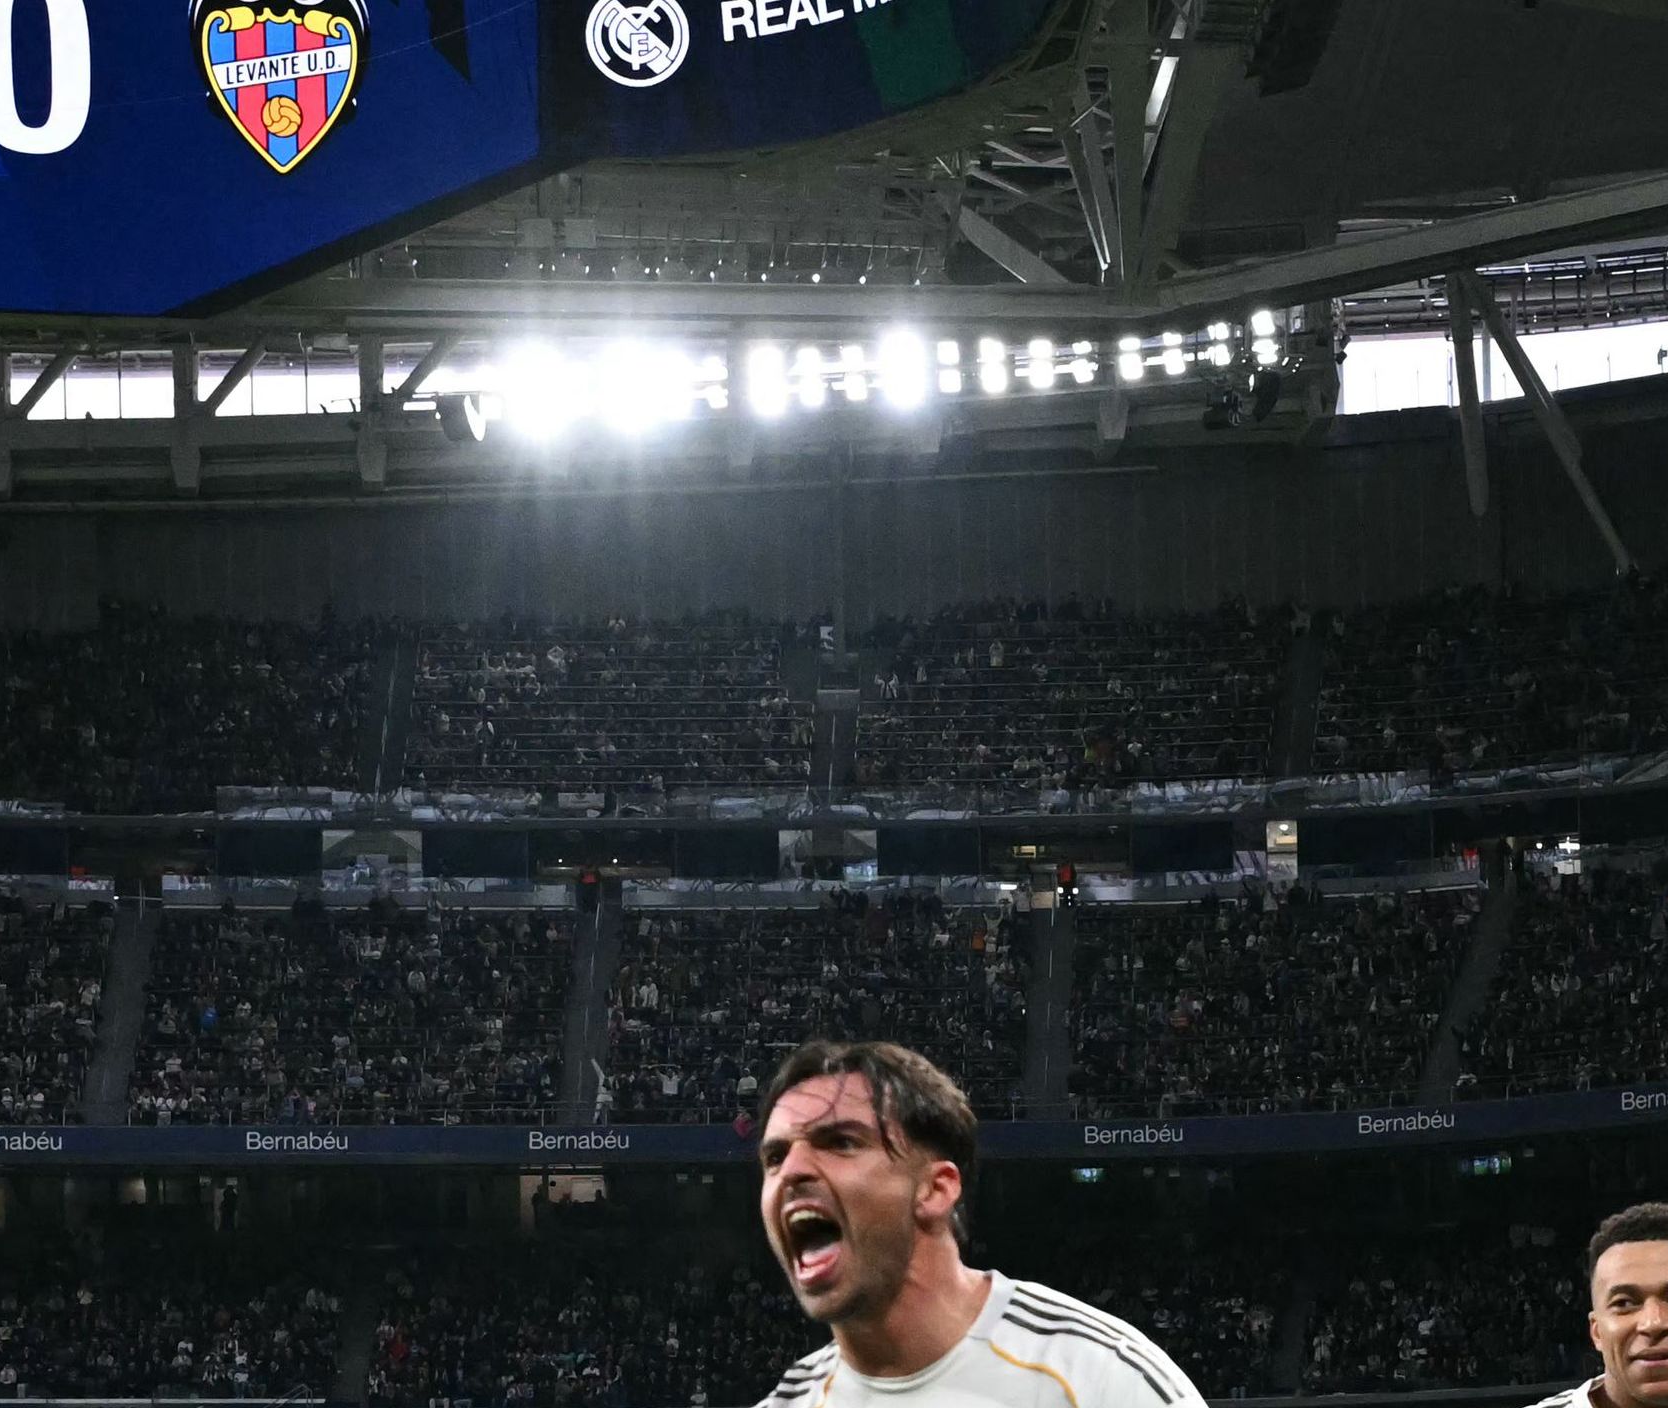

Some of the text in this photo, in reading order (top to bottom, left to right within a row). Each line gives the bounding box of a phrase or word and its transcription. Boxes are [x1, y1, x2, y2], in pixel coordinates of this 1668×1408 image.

[721, 0, 845, 42] REAL
[225, 49, 343, 86] LEVANTE U.D.
[1084, 1123, 1183, 1144] Bernabéu
[1358, 1112, 1455, 1134] Bernabéu
[246, 1130, 348, 1150] Bernabéu
[529, 1130, 630, 1149] Bernabéu
